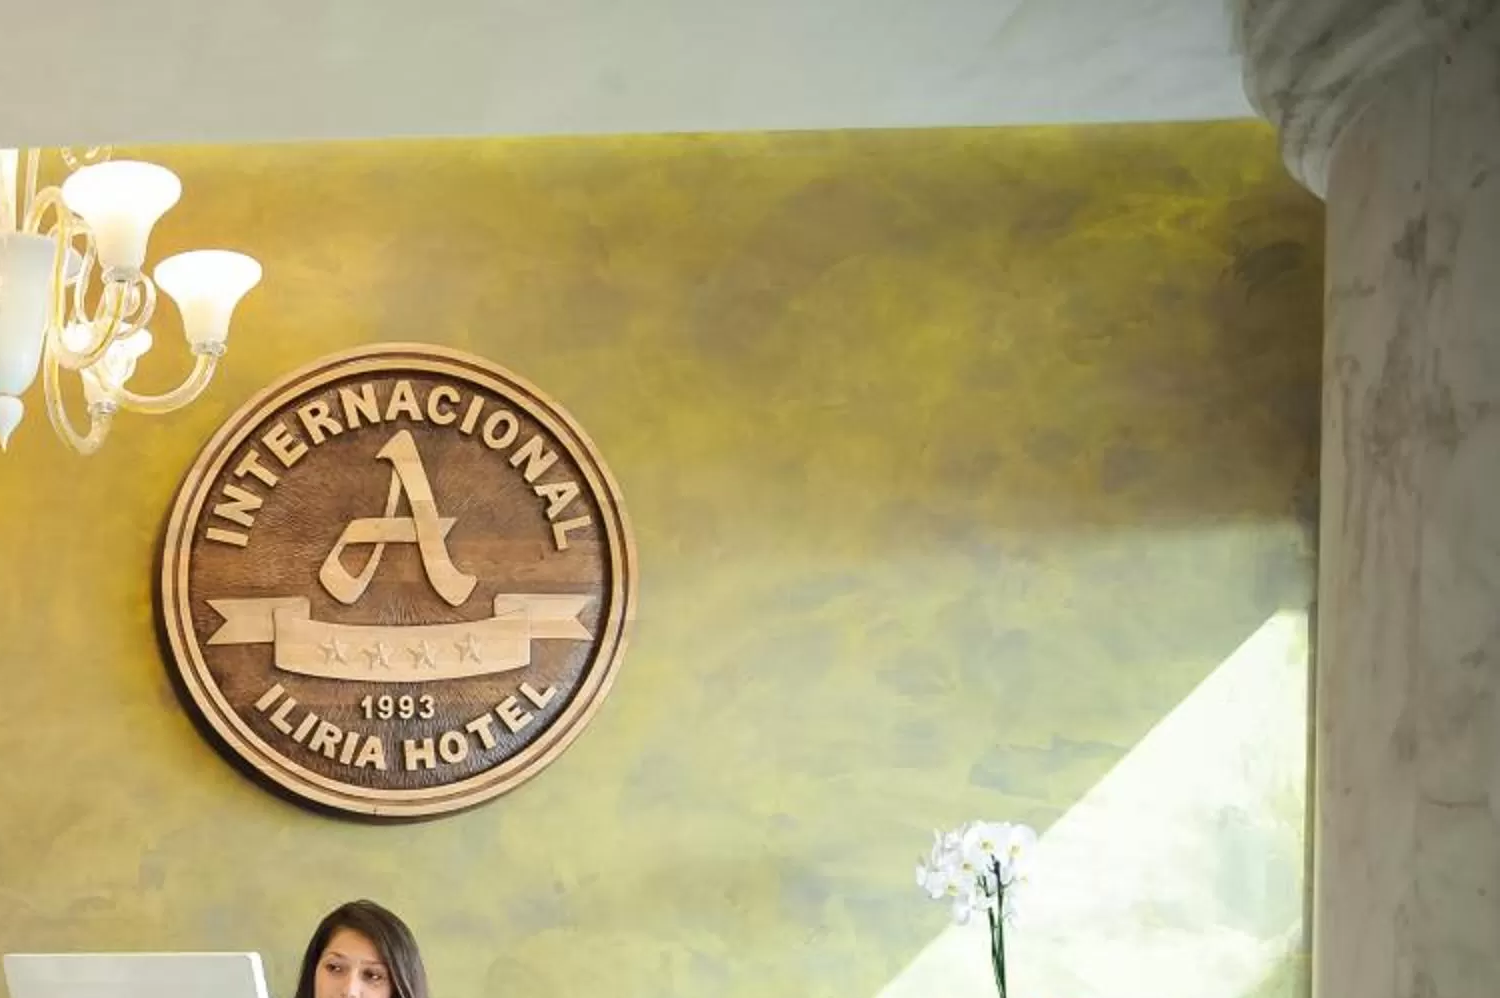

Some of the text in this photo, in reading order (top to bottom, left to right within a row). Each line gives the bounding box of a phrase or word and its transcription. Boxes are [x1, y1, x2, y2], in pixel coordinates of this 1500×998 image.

[205, 379, 594, 551] INTERNACIONAL
[318, 428, 478, 607] A
[253, 681, 557, 771] ILIRIA HOTEL
[360, 694, 436, 720] 1993
